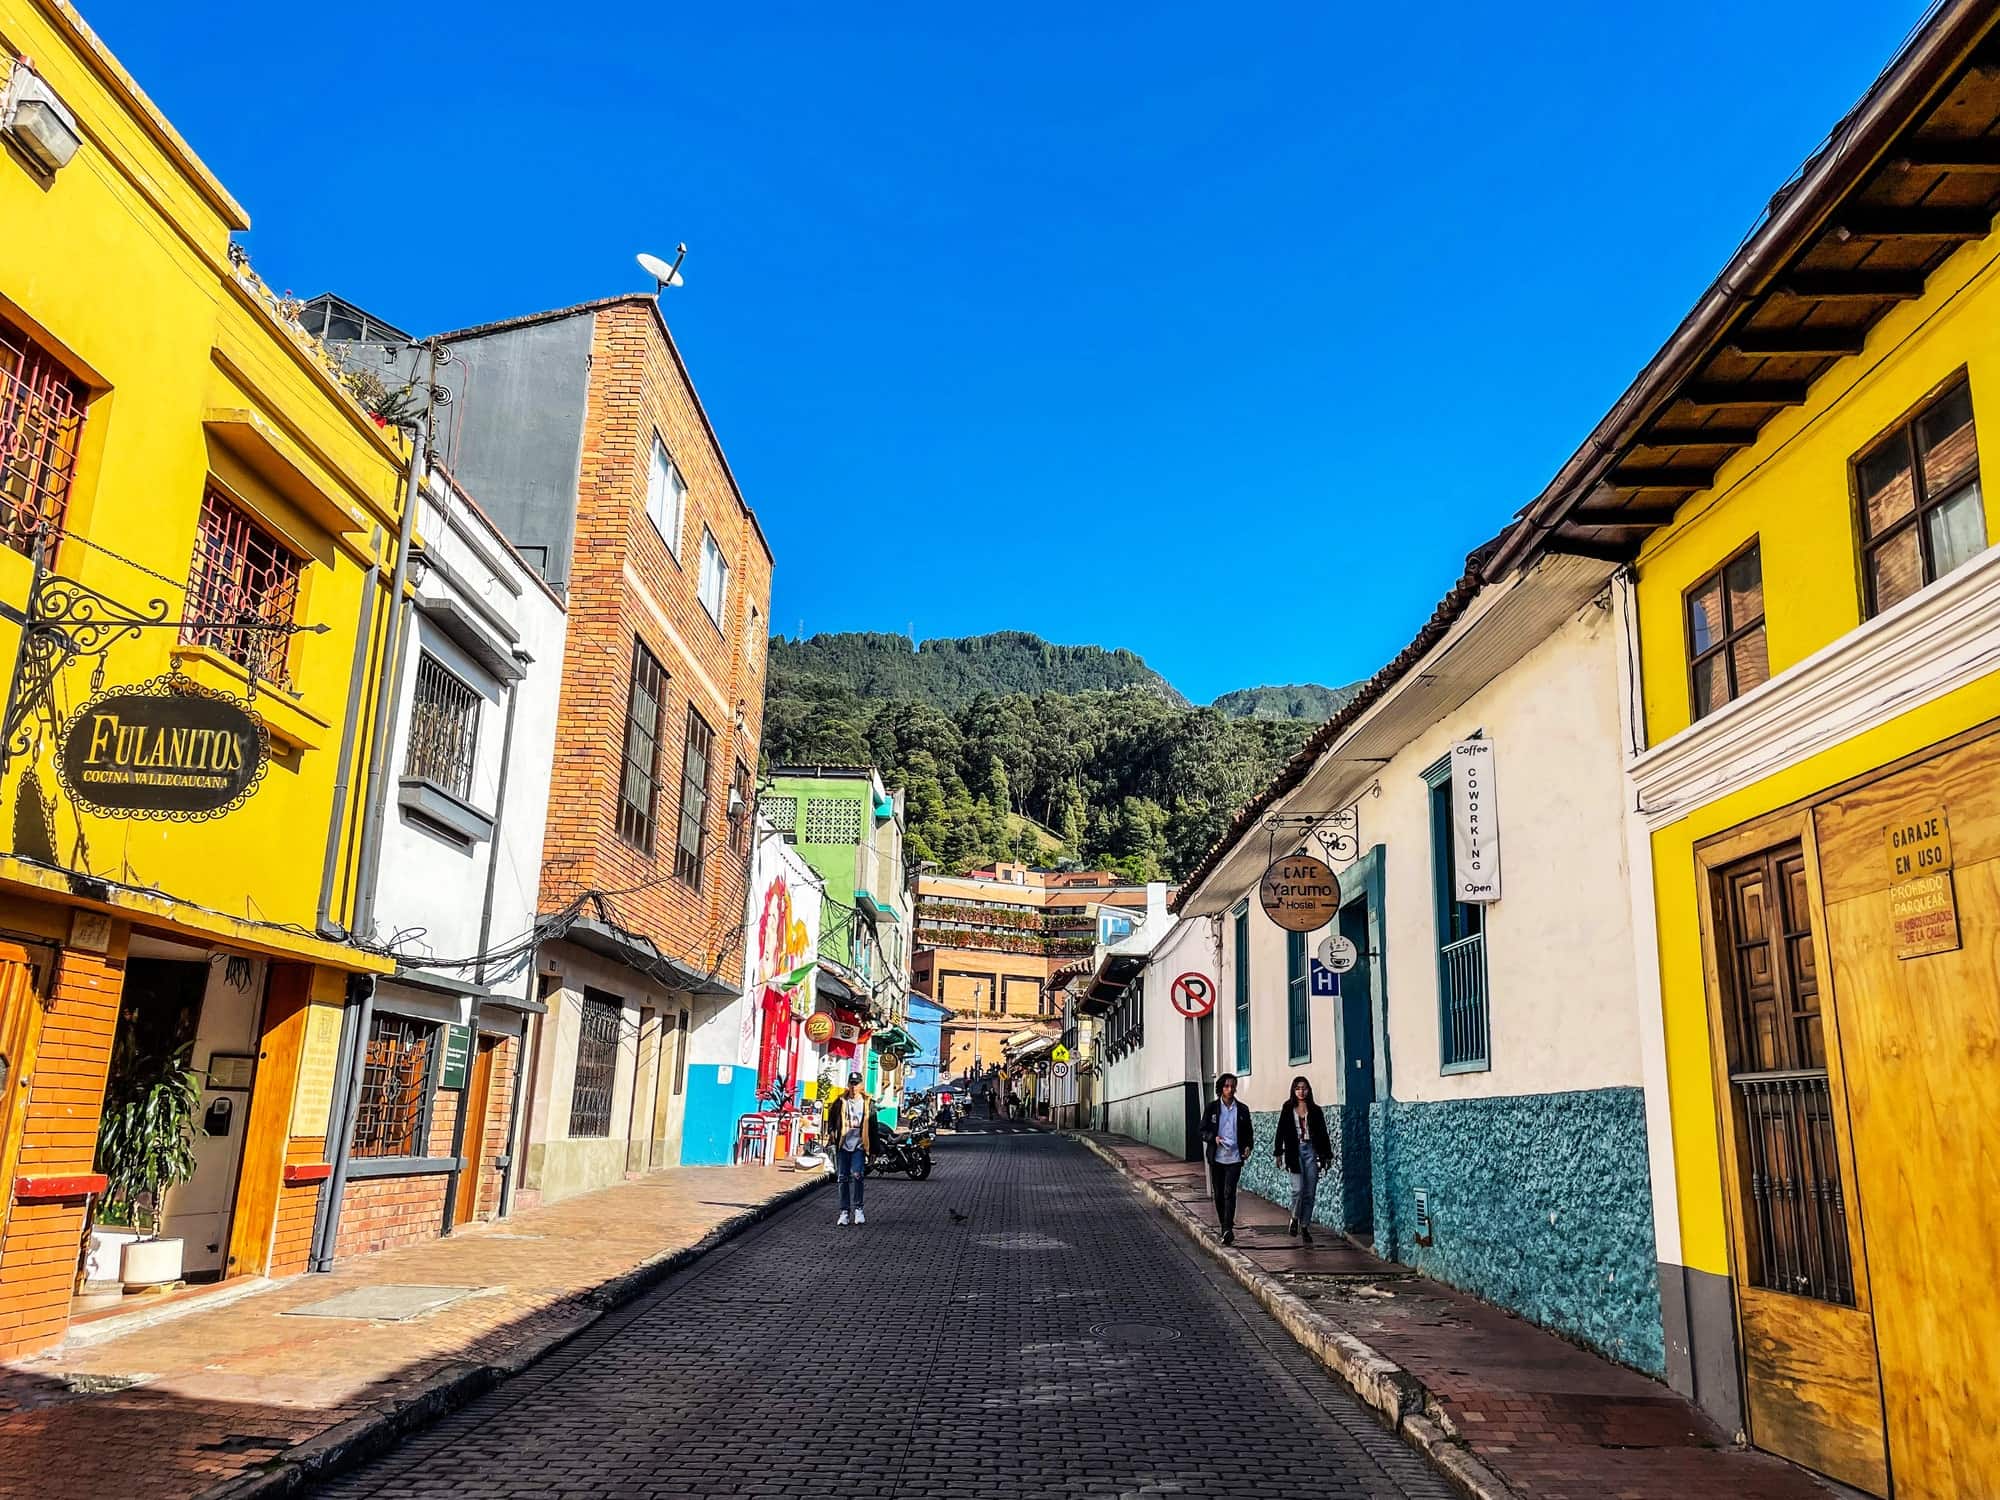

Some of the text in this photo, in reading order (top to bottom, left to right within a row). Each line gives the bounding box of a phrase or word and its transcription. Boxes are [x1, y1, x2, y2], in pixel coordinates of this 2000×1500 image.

[83, 714, 242, 771] FULANITOS
[1456, 744, 1488, 756] Coffee
[83, 770, 228, 789] COCINA VALLECAUCANA
[1468, 768, 1481, 870] COWORKING
[1893, 817, 1939, 848] GARAJE
[1896, 846, 1942, 875] EN USO
[1284, 866, 1318, 879] CAFE
[1269, 882, 1332, 897] Yarumo
[1464, 883, 1491, 895] Open
[1891, 875, 1943, 900] PROHIBIDO
[1286, 900, 1316, 910] Hostel
[1894, 891, 1945, 915] PARQUEAR
[1318, 972, 1332, 990] H
[1184, 979, 1206, 1010] P
[1055, 1065, 1066, 1074] 30
